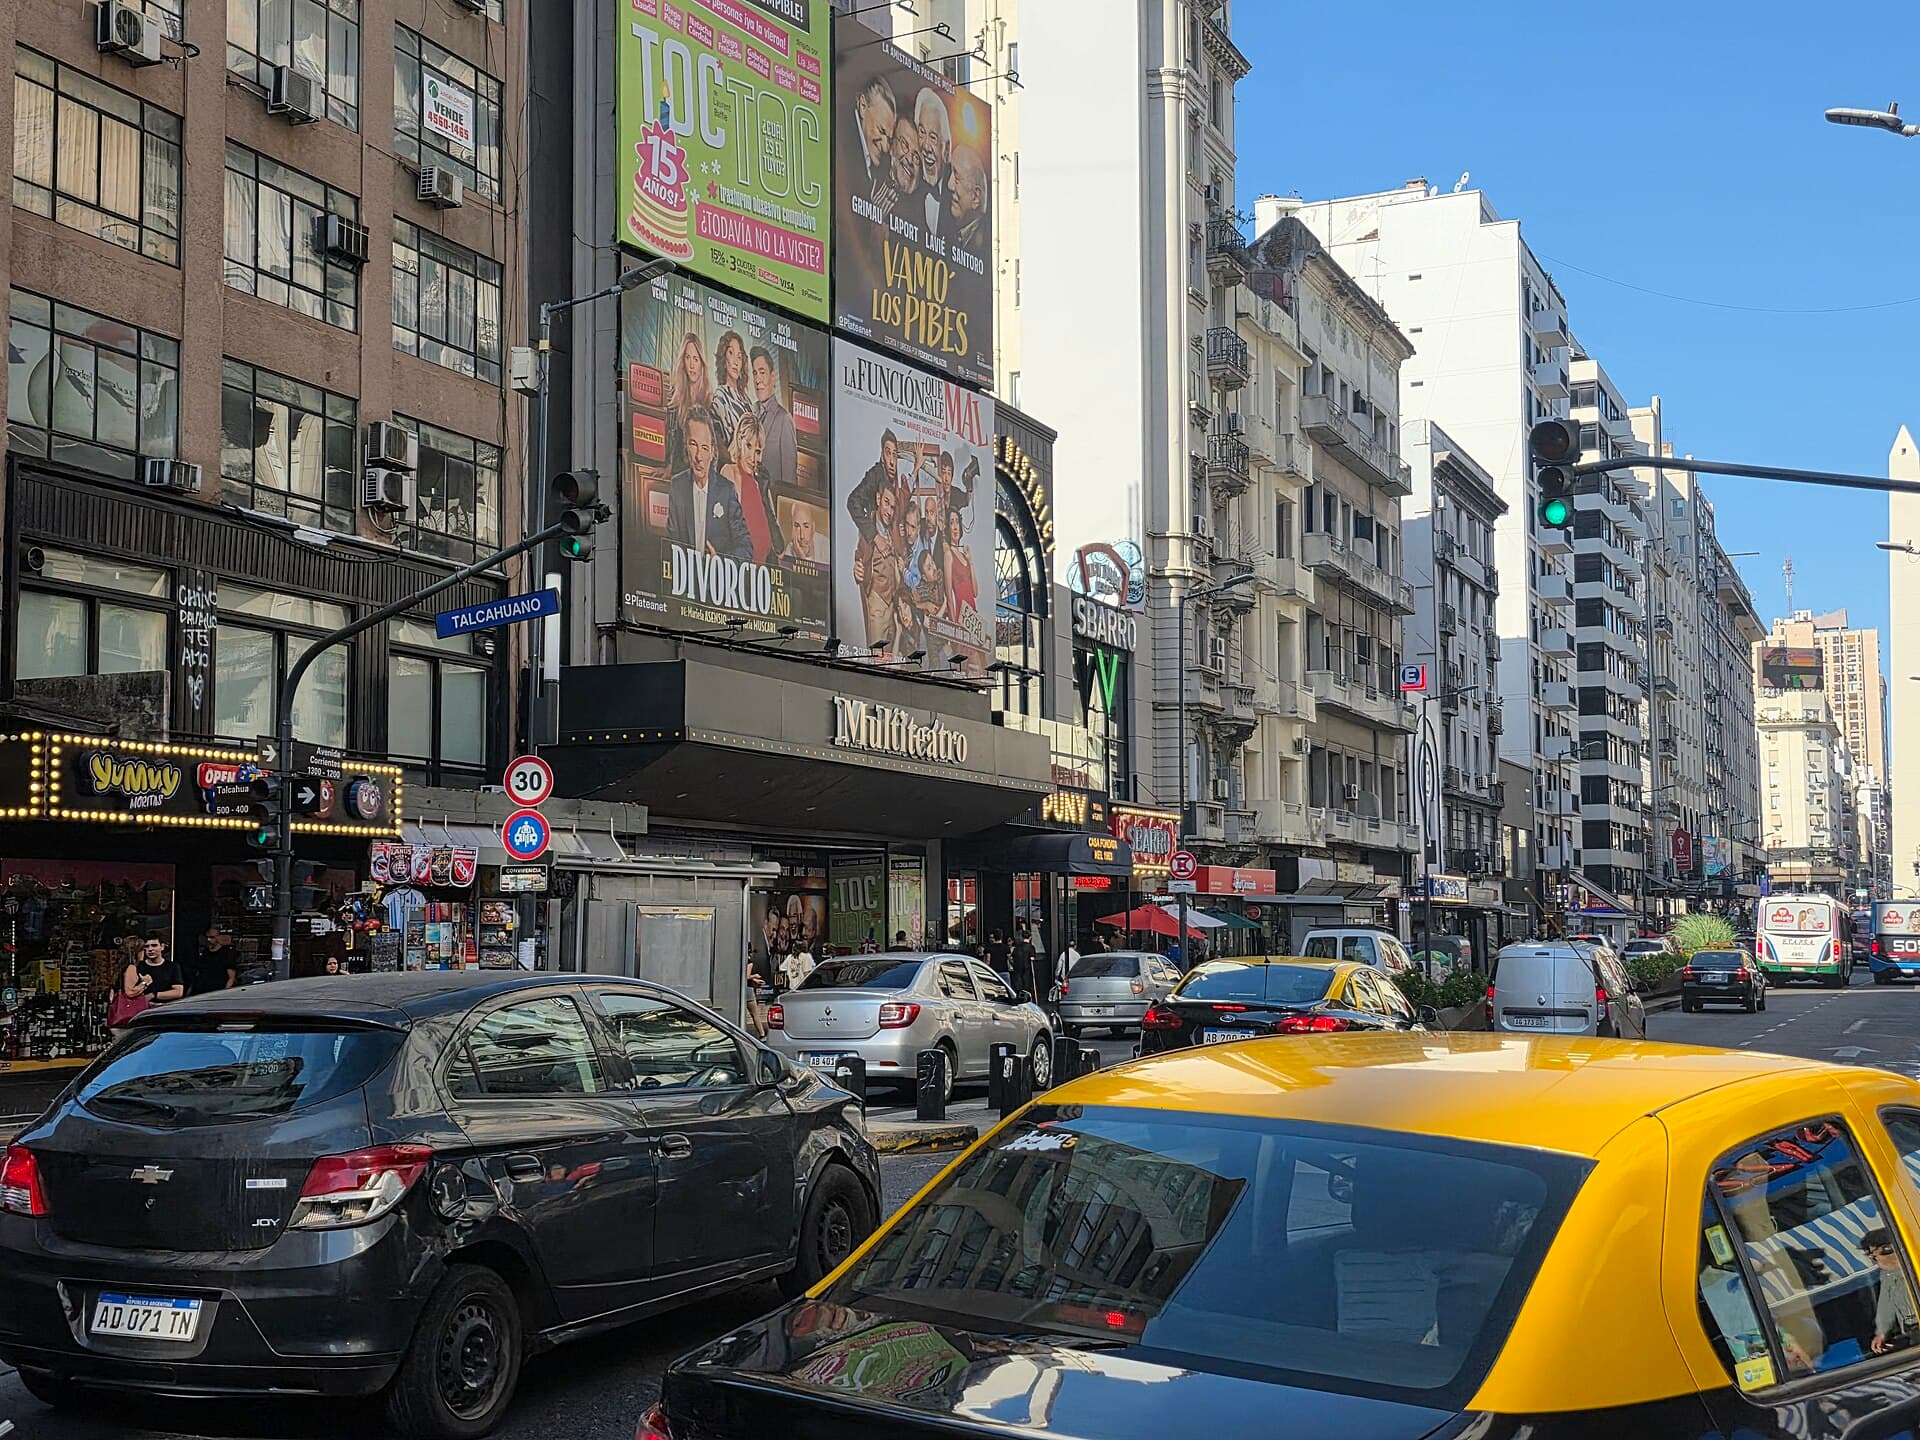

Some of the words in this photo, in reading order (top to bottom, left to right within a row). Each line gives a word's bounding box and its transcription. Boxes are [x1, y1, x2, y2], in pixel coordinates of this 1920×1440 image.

[711, 0, 743, 22] personas
[756, 16, 763, 32] la
[763, 24, 786, 50] vieron!
[721, 34, 738, 49] Diego
[882, 42, 889, 55] LA
[890, 47, 911, 68] AMISTAD
[912, 59, 920, 74] NO
[631, 23, 725, 149] TOC
[433, 100, 464, 126] VENDE
[726, 76, 822, 208] TOC
[647, 135, 677, 186] 15
[763, 156, 785, 176] TUYO?
[643, 176, 678, 208] AÑOS!
[752, 195, 781, 222] obsesivo
[702, 210, 752, 248] ¿TODAVÍA
[755, 227, 770, 253] NO
[773, 232, 785, 258] LA
[788, 238, 820, 269] VISTE?
[851, 195, 883, 225] GRIMAU
[889, 214, 919, 243] LAPORT
[925, 231, 946, 257] LAVIÉ
[951, 245, 984, 275] SANTORO
[730, 256, 736, 271] 3
[780, 278, 795, 291] VISA
[872, 288, 901, 327] LOS
[904, 293, 968, 357] PIBES
[844, 366, 856, 388] LA
[857, 357, 925, 415] FUNCIÓN
[925, 376, 943, 401] QUE
[924, 396, 944, 421] SALE
[943, 380, 988, 447] MAL
[663, 560, 672, 580] EL
[671, 544, 771, 615] DIVORCIO
[771, 567, 783, 587] DEL
[451, 597, 541, 629] TALCAHUANO
[631, 594, 668, 613] Plateanet
[770, 588, 790, 618] AÑO
[1073, 597, 1137, 652] SBARRO
[309, 756, 341, 769] Corrientes
[316, 747, 341, 759] Avenida
[205, 770, 237, 784] OPEN
[307, 766, 322, 777] 1300
[327, 769, 341, 779] 1200
[515, 771, 542, 791] 30
[216, 805, 230, 815] 500
[235, 805, 249, 814] 400
[1127, 825, 1170, 855] SBARRO
[835, 875, 879, 912] TOC
[1893, 940, 1920, 953] 50
[1206, 1033, 1217, 1043] AB
[251, 1218, 280, 1227] JOY
[97, 1305, 123, 1330] AD
[127, 1308, 162, 1333] 071
[169, 1311, 192, 1335] TN
